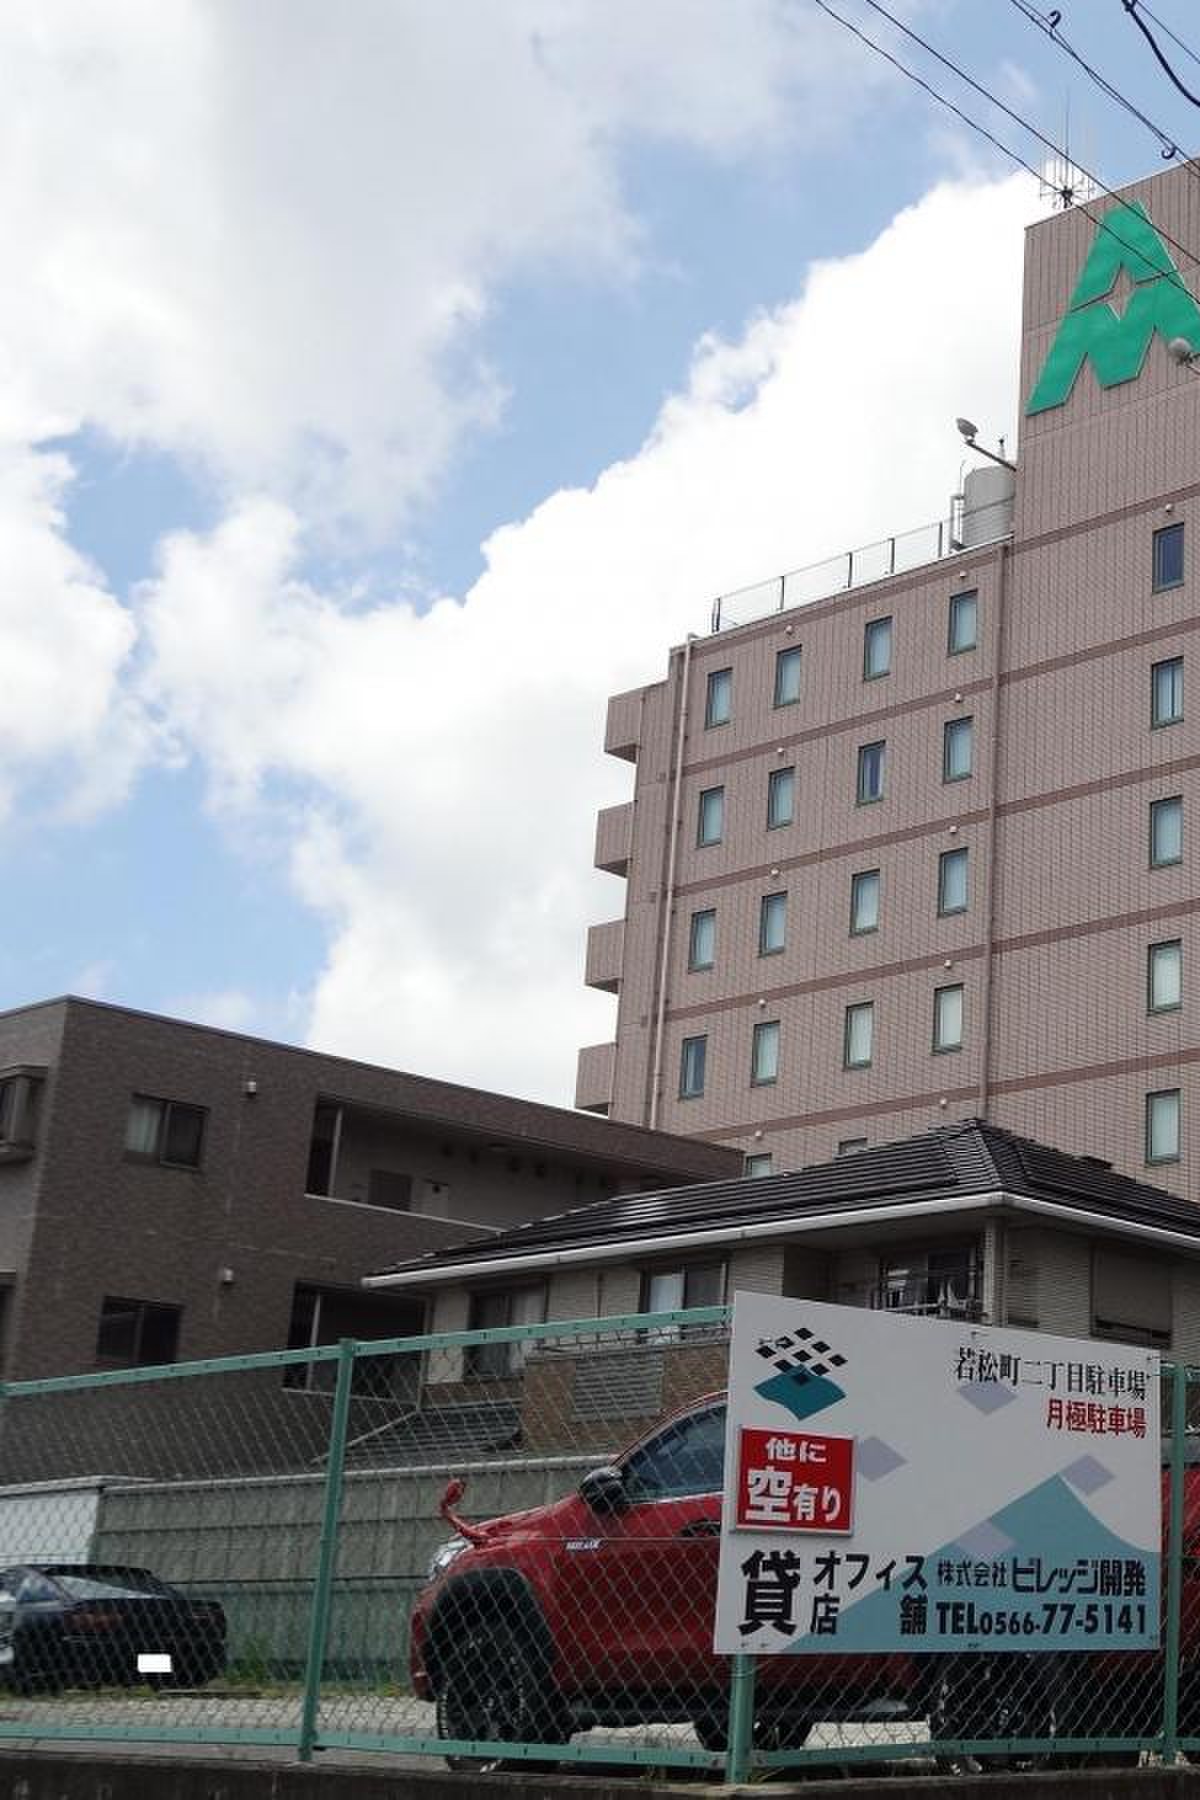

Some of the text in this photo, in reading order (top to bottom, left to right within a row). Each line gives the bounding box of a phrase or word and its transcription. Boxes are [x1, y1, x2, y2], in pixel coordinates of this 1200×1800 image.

[955, 1347, 1147, 1401] 若松町二丁目駐車場
[1046, 1399, 1147, 1439] 月極駐車場
[765, 1437, 827, 1463] 他に
[744, 1466, 841, 1522] 空有り
[738, 1550, 800, 1636] 貸
[812, 1552, 928, 1591] オフィス
